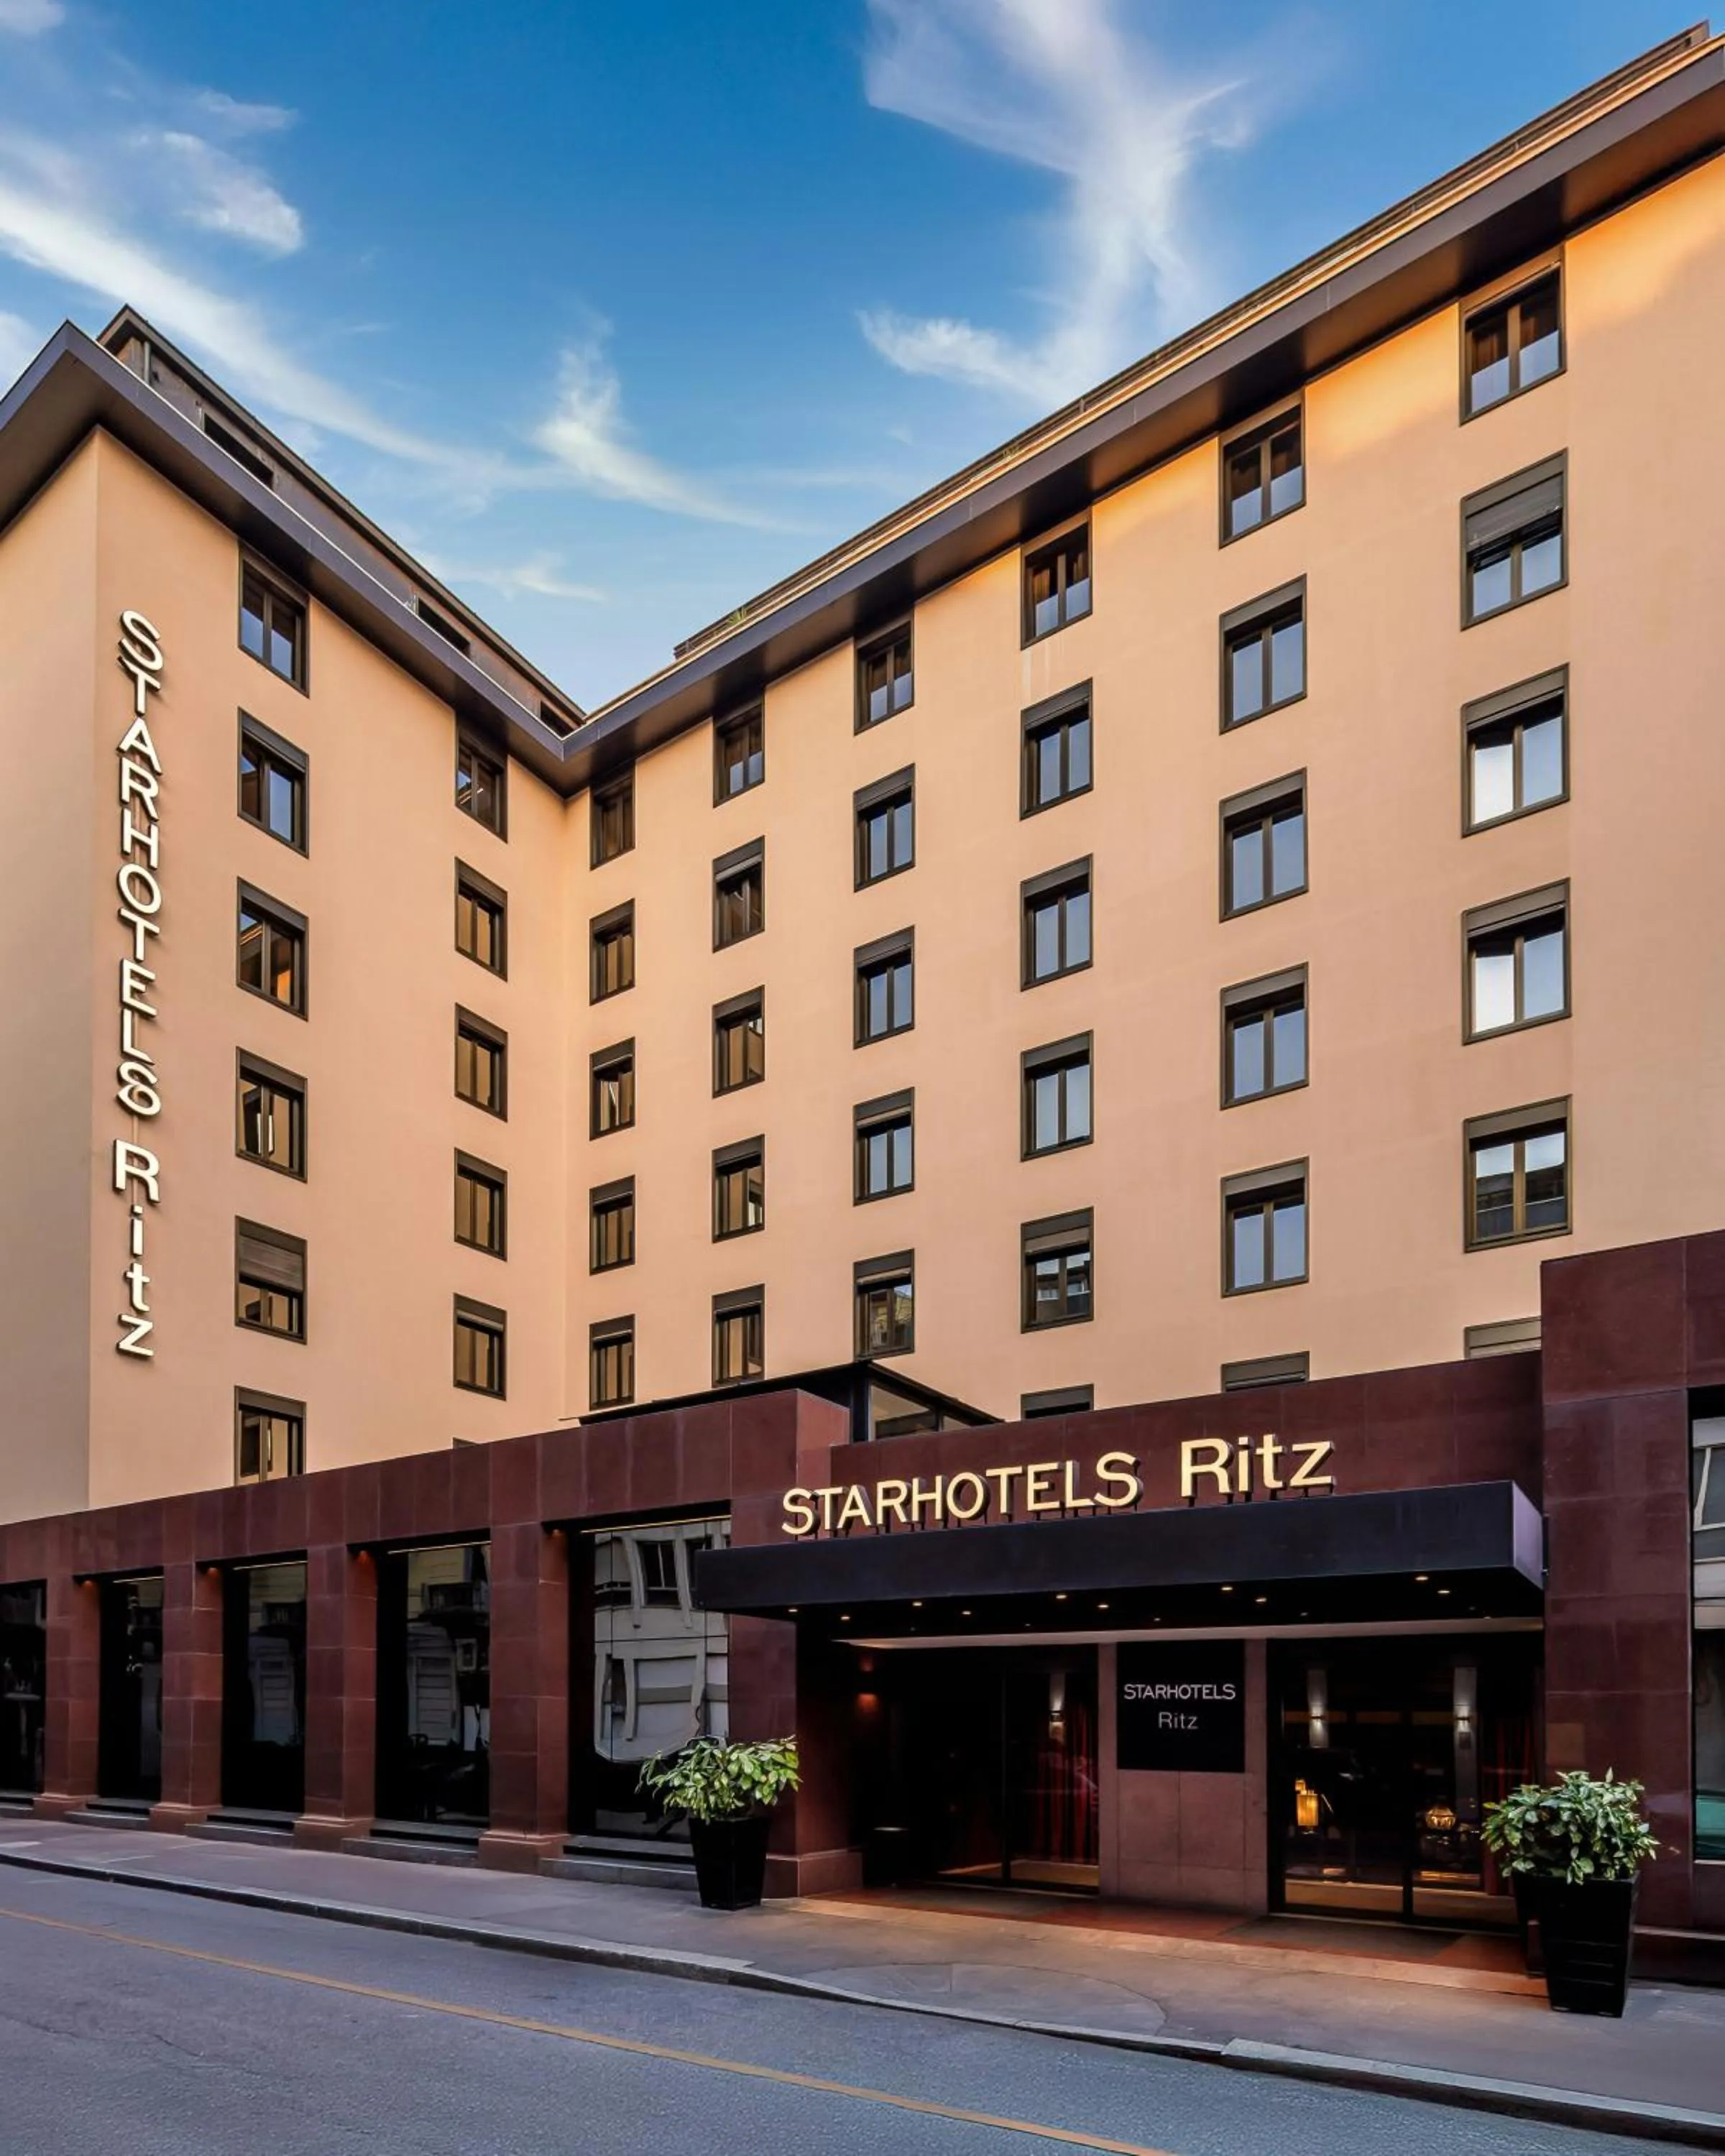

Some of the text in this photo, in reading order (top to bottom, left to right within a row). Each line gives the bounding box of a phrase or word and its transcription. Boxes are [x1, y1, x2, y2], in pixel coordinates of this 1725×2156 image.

[113, 609, 164, 1357] STARHOTELS Ritz
[781, 1433, 1336, 1537] STARHOTELS Ritz
[1123, 1684, 1236, 1700] STARHOTELS
[1158, 1711, 1198, 1729] Ritz
